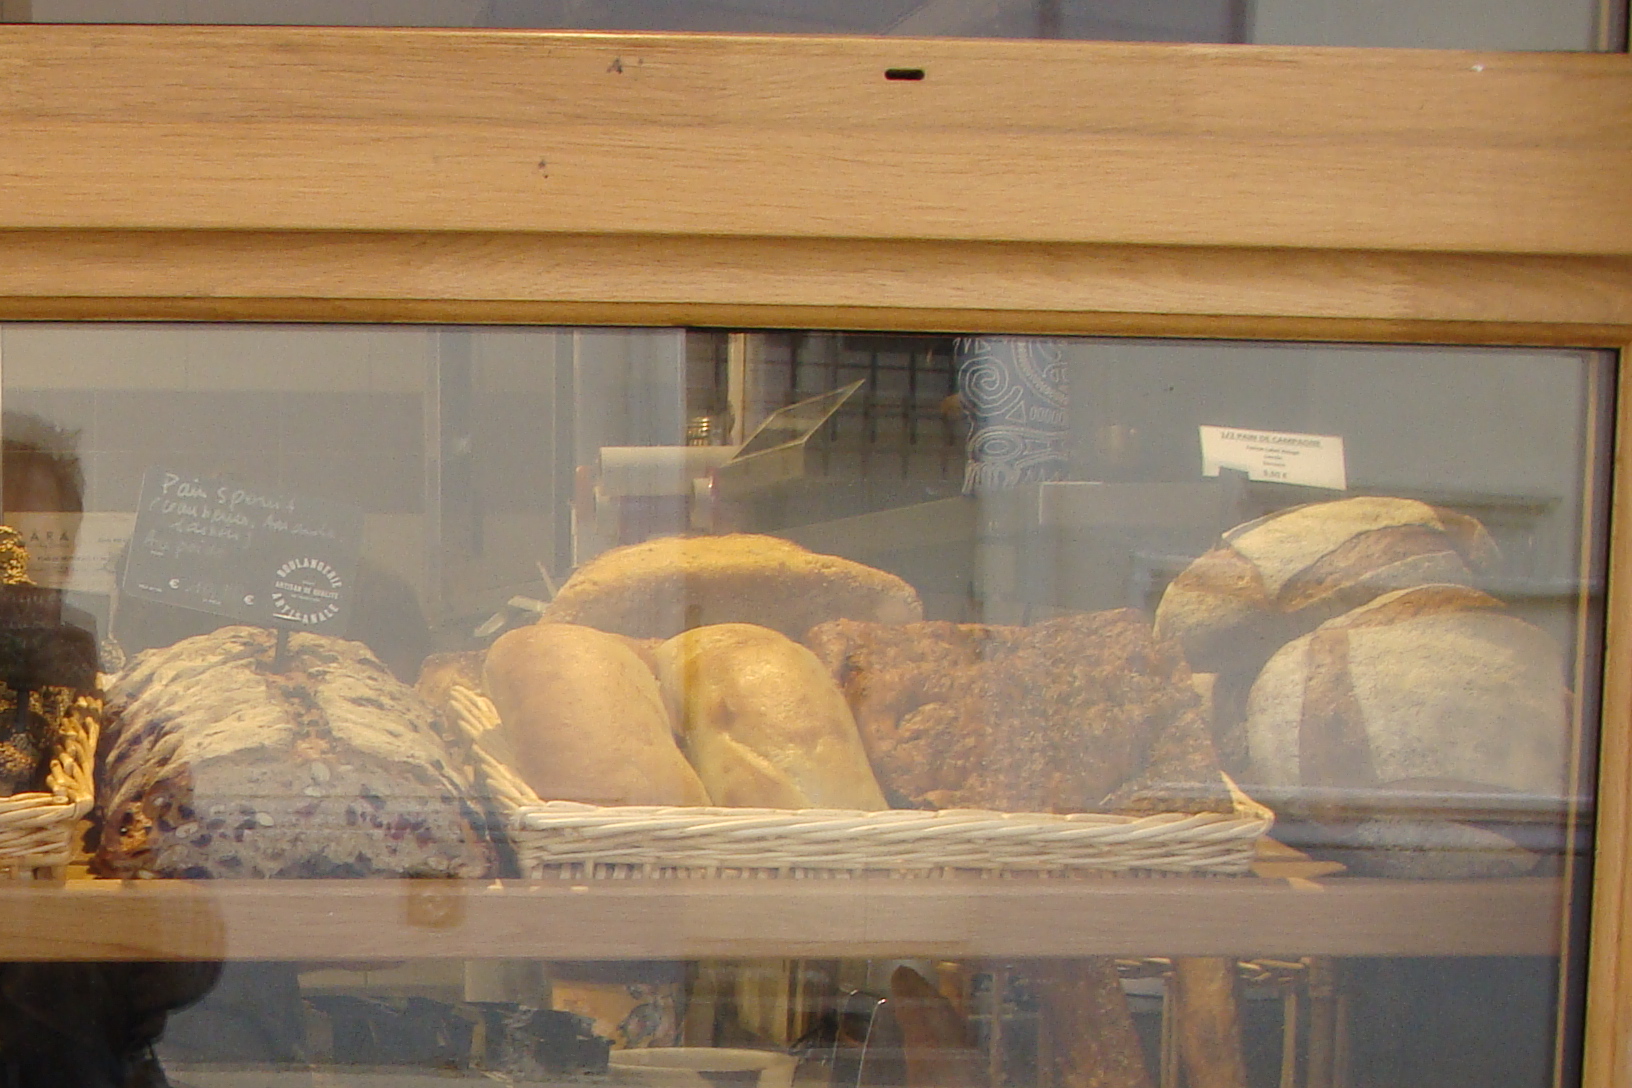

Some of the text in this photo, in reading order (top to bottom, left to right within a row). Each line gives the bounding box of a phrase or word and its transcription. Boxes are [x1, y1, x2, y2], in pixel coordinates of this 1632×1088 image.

[1236, 432, 1257, 442] PAIN
[1259, 434, 1270, 443] DE
[1272, 435, 1321, 448] CAMPAGNE
[276, 557, 343, 589] BOULANGERIE
[275, 580, 302, 592] ARTISAN
[271, 592, 340, 625] ARTISANALE
